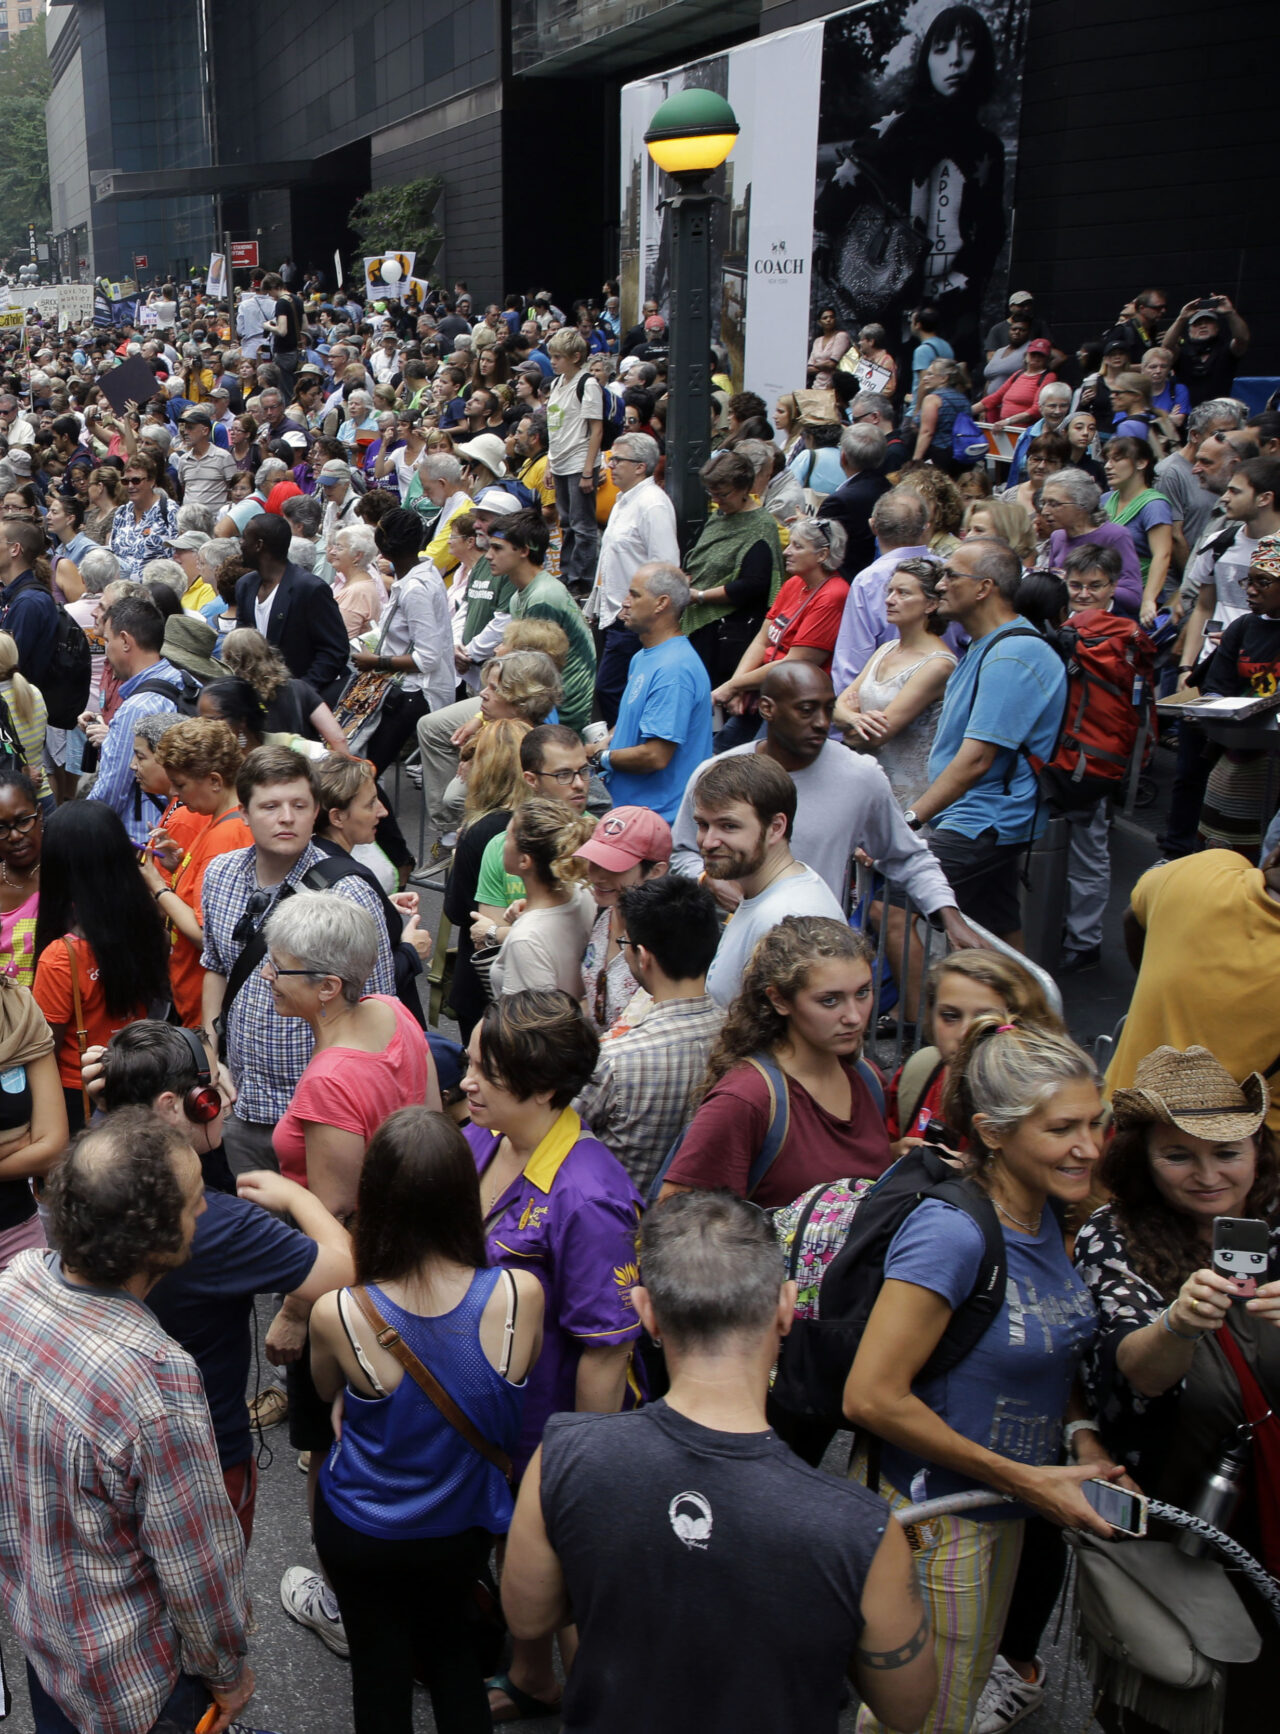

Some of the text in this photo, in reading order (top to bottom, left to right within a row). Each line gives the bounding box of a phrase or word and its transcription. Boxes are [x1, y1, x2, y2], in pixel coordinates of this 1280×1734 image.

[935, 165, 950, 252] APOLLO
[28, 231, 37, 256] PARK
[754, 259, 804, 275] COACH
